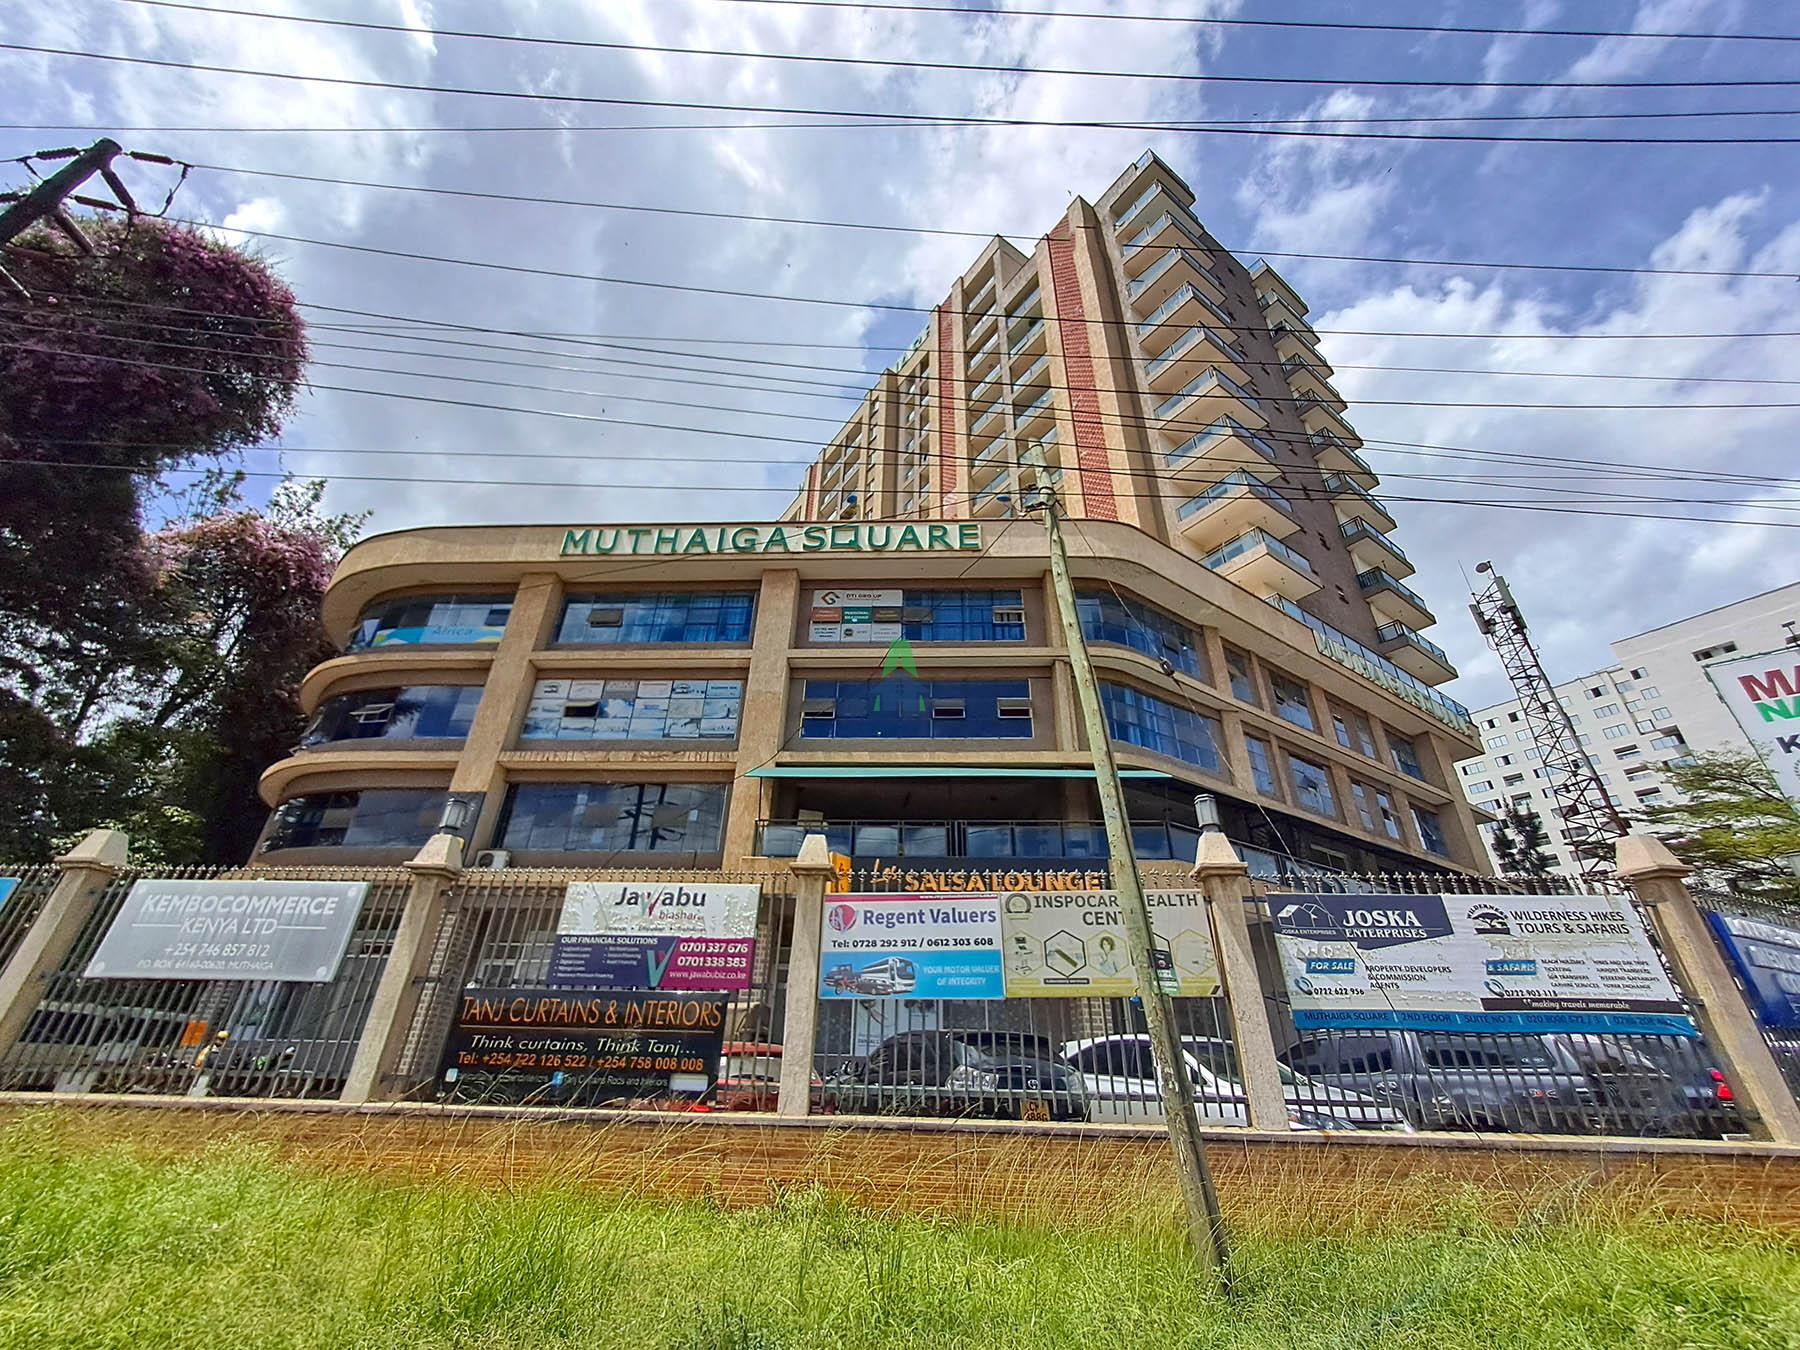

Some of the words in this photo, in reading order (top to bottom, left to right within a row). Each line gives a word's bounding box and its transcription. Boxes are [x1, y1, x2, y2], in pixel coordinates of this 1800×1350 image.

[561, 526, 790, 555] MUTHAIGA
[802, 524, 981, 553] SQUARE
[1737, 665, 1800, 702] M
[1755, 695, 1800, 723] N
[904, 871, 986, 892] SALSA
[992, 871, 1102, 892] LOUNGE
[141, 895, 339, 915] KEMBOCOMMERCE
[615, 886, 707, 913] Jawabu
[1034, 894, 1120, 909] INSPOCAR
[1147, 894, 1199, 907] EALTH
[863, 909, 926, 928] Regent
[929, 907, 997, 924] Valuers
[1343, 910, 1422, 927] JOSKA
[1510, 910, 1587, 922] WILDERNESS
[1590, 911, 1624, 921] HIKES
[180, 918, 241, 934] KENYA
[243, 919, 278, 935] LTD
[1516, 922, 1561, 934] TOURS
[1564, 923, 1575, 934] &
[1578, 923, 1630, 935] SAFARIS
[1345, 928, 1427, 939] ENTERPRISES
[561, 936, 577, 945] OUR
[578, 936, 616, 945] FINANCIAL
[617, 936, 658, 945] SOLUTIONS
[831, 939, 850, 948] Tel:
[852, 939, 877, 948] 0728
[880, 939, 898, 948] 292
[900, 939, 917, 948] 912
[927, 938, 950, 947] 0612
[952, 938, 971, 947] 303
[974, 937, 993, 947] 608
[164, 943, 196, 957] +254
[197, 943, 221, 957] 746
[222, 943, 247, 957] 857
[248, 944, 271, 957] 812
[728, 943, 748, 954] 676
[727, 958, 747, 968] 383
[944, 965, 970, 974] MOTOR
[1310, 961, 1330, 970] FOR
[1331, 961, 1354, 970] SALE
[1365, 965, 1402, 973] PROPERTY
[1404, 966, 1452, 974] DEVELOPERS
[936, 977, 947, 986] OF
[948, 977, 986, 985] INTEGRITY
[1370, 982, 1400, 990] AGENTS
[1313, 987, 1333, 996] 0722
[1334, 987, 1348, 995] 622
[1561, 1000, 1586, 1008] travels
[1588, 1001, 1630, 1009] memorable
[461, 996, 506, 1021] TANJ
[509, 997, 600, 1024] CURTAINS
[604, 1000, 618, 1024] &
[623, 1000, 722, 1027] INTERIORS
[1304, 1012, 1352, 1021] MUTHAIGA
[1354, 1012, 1389, 1021] SQUARE
[1402, 1013, 1420, 1022] 2ND
[1423, 1014, 1451, 1022] FLOOR
[1465, 1014, 1490, 1023] SUITE
[470, 1035, 513, 1050] Think
[518, 1037, 588, 1053] curtains,
[596, 1037, 641, 1053] Think
[648, 1039, 696, 1055] Tanj...
[457, 1051, 478, 1065] Tel:
[482, 1052, 512, 1065] +254
[539, 1053, 560, 1066] 126
[564, 1053, 586, 1067] 522
[597, 1055, 626, 1069] +254
[630, 1056, 651, 1069] 758
[655, 1057, 677, 1070] 008
[680, 1058, 704, 1071] 008
